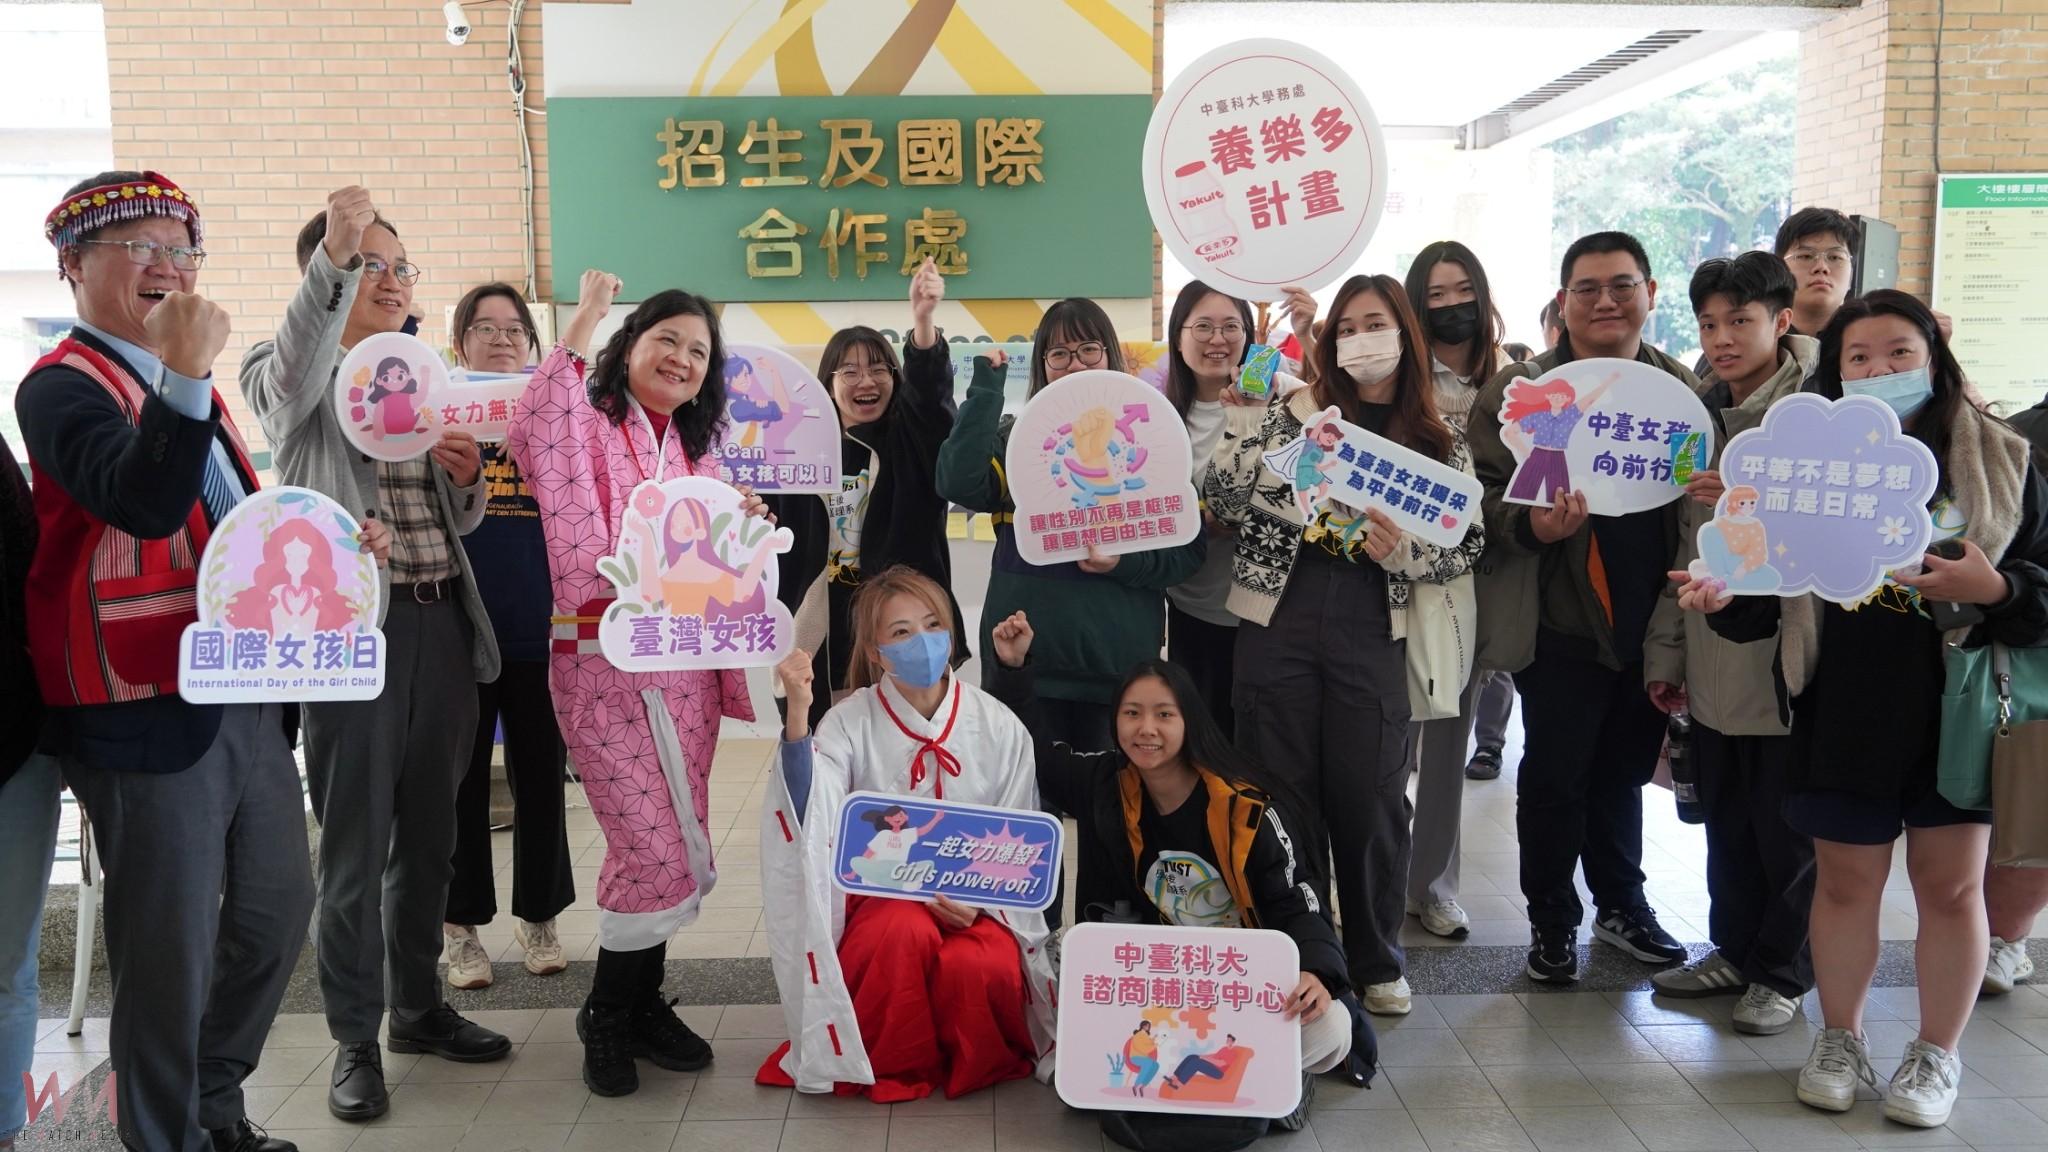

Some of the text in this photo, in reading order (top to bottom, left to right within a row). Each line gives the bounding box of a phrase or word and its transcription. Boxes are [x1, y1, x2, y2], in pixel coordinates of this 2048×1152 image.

[1200, 84, 1307, 117] 中臺科大學務處
[657, 117, 1044, 189] 招生及國際
[1208, 106, 1353, 176] 養樂多
[1179, 191, 1224, 210] Yakult
[1246, 169, 1345, 231] 計畫
[738, 207, 970, 280] 合作處
[1204, 249, 1236, 263] Yakult
[1337, 442, 1468, 512] 為臺灣女孩喝采
[1592, 450, 1672, 483] 向前行
[1740, 455, 1913, 491] 平等不是夢想
[1029, 494, 1184, 534] 讓性別不再是框架
[1346, 470, 1442, 524] 為平等前行
[1764, 487, 1880, 520] 而是日常
[1042, 516, 1178, 553] 讓夢想自由生長
[190, 630, 377, 671] 國際女孩日
[629, 614, 777, 658] 臺灣女孩
[187, 677, 377, 690] International Day of the Girl Child
[890, 861, 1042, 895] Girls power on!
[1114, 941, 1249, 976] 中臺科大
[1082, 974, 1288, 1013] 諮商輔導中心
